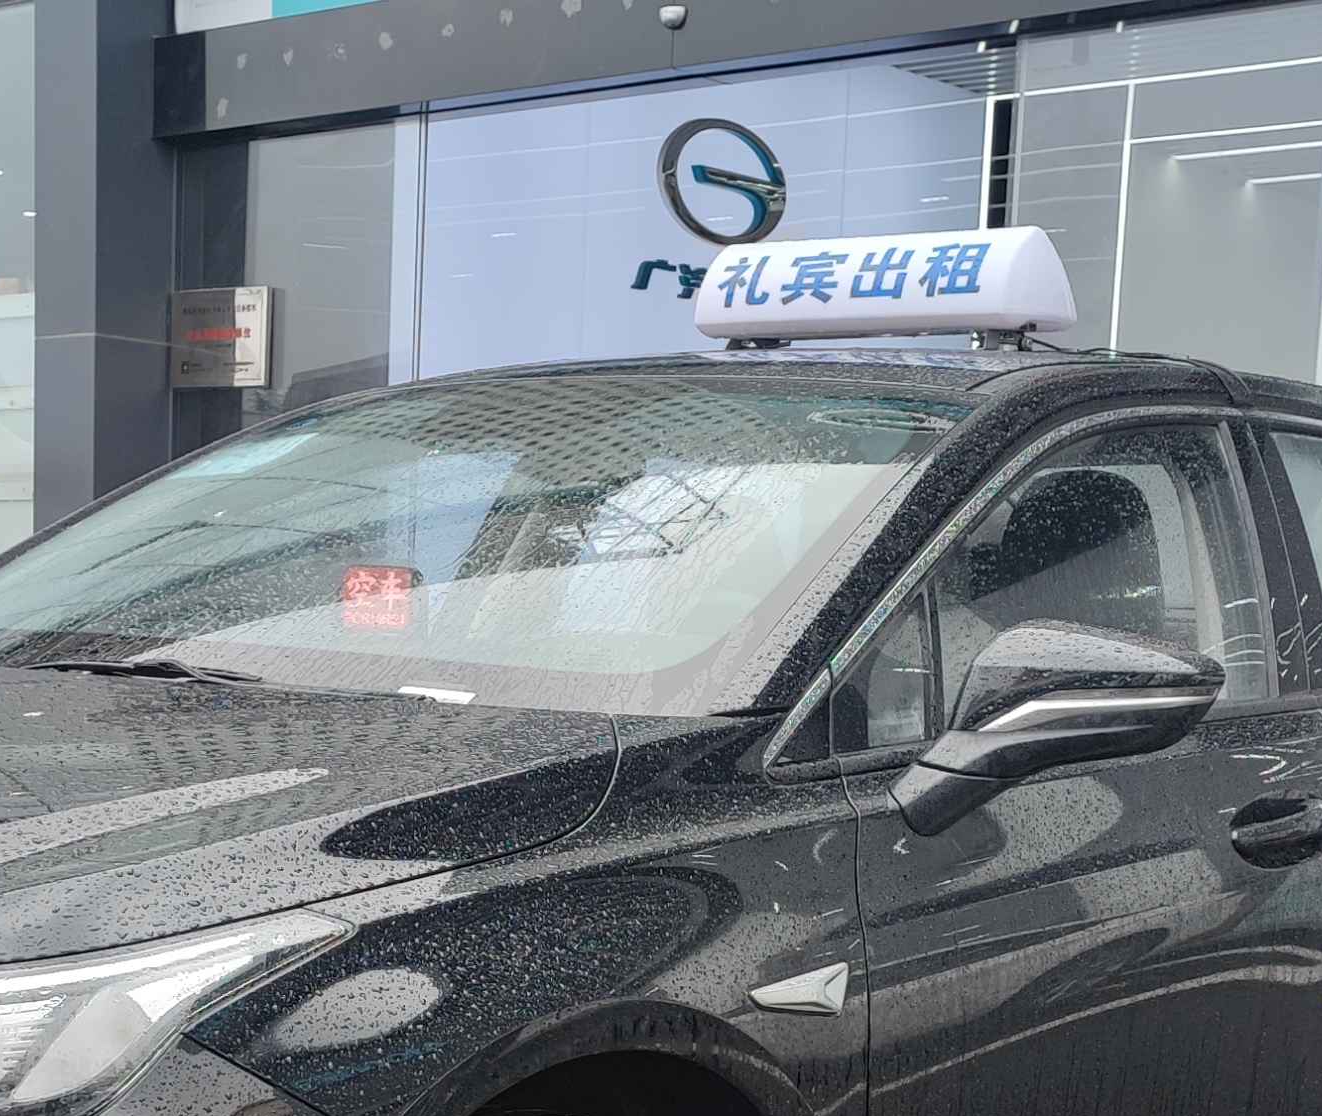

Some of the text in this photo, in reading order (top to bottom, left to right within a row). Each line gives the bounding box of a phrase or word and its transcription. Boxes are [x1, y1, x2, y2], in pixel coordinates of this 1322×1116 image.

[717, 243, 992, 308] 礼宾出租
[345, 570, 408, 612] 空车
